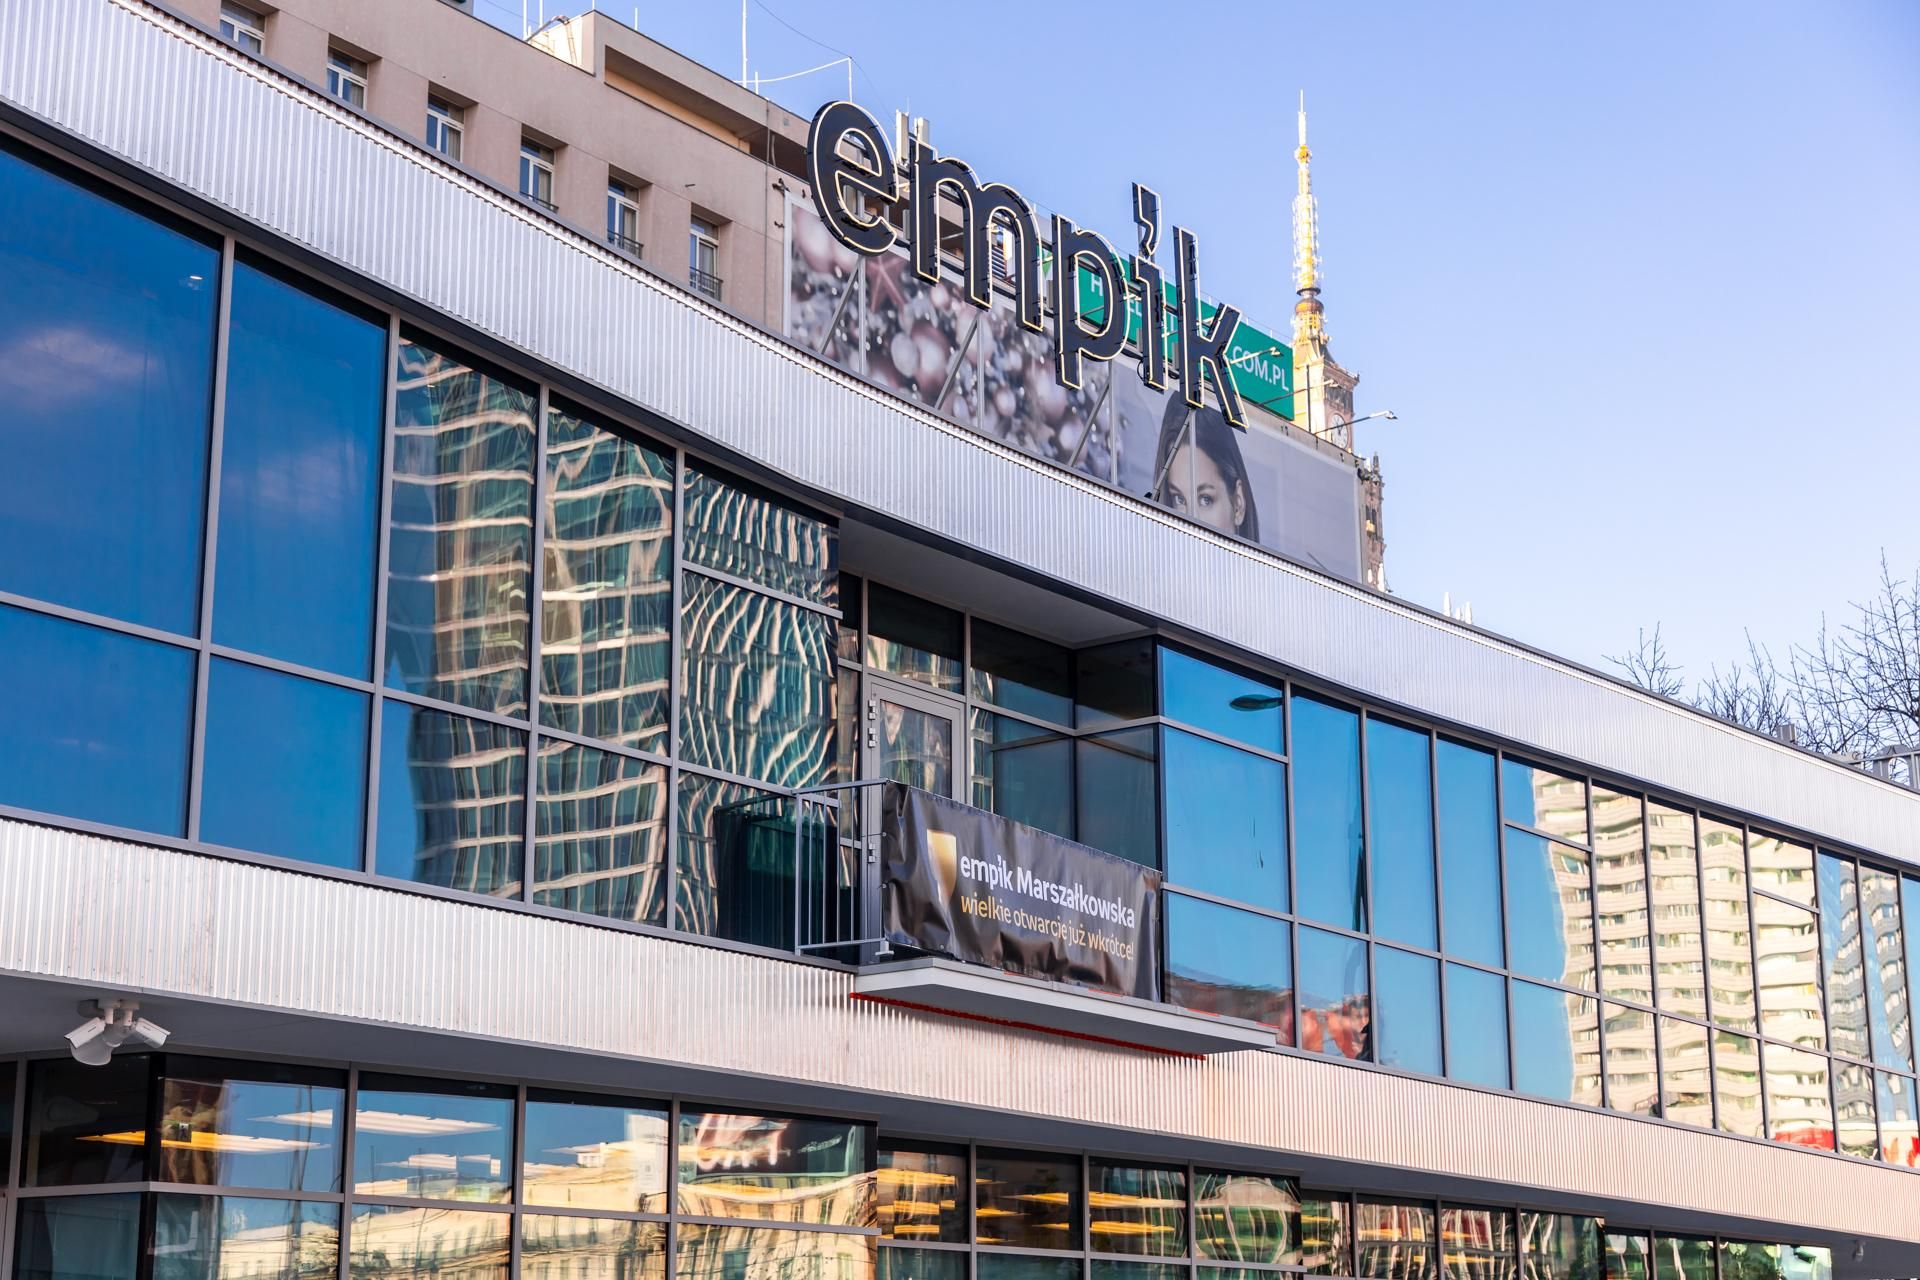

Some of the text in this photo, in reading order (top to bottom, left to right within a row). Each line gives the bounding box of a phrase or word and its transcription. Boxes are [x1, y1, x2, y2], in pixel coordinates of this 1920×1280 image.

[806, 100, 1249, 433] empik
[960, 855, 1135, 929] empik Marszałkowska
[960, 892, 1134, 961] wielkie otwarcie już wkrótce!
